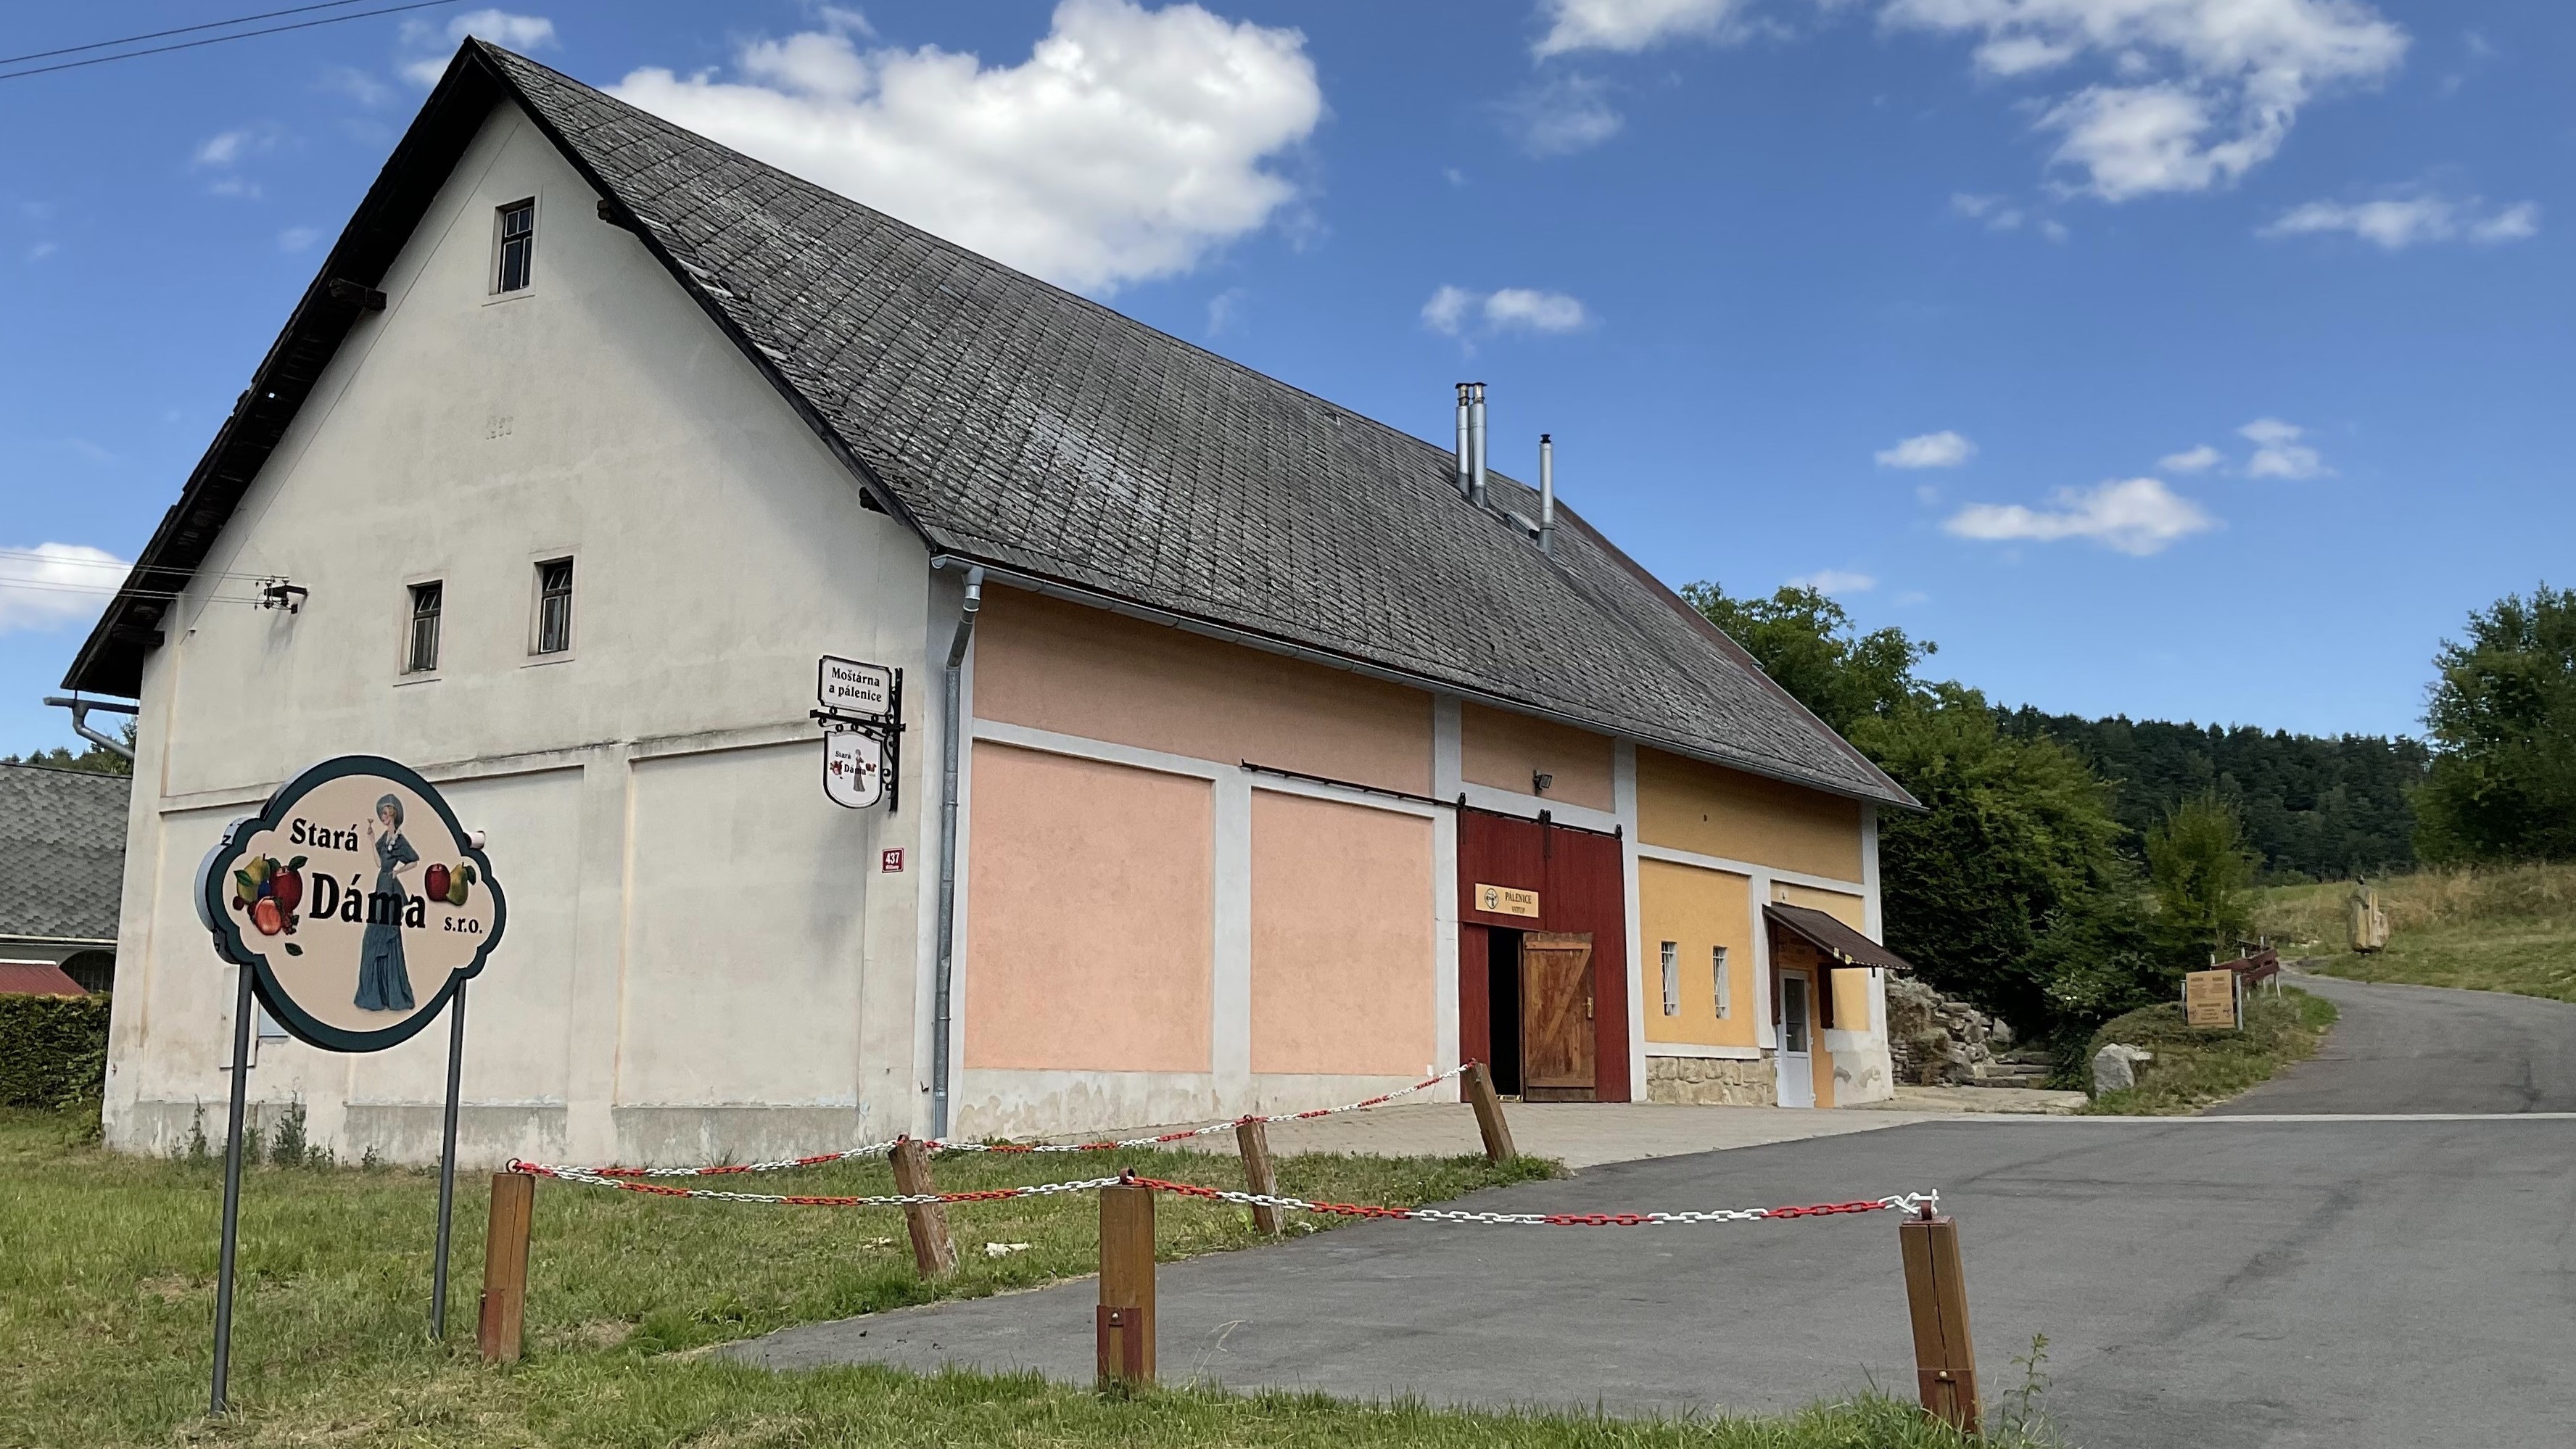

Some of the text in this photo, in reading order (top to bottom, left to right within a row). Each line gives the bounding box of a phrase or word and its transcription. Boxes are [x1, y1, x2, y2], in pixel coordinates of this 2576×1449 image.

[832, 666, 880, 687] Moštárna
[829, 685, 882, 702] a pálenice
[844, 764, 866, 775] Dáma
[289, 817, 358, 851] Stará
[886, 852, 900, 864] 437
[309, 872, 426, 928] Dáma
[1506, 891, 1532, 904] PÁLENICE
[444, 915, 483, 934] s.r.o.
